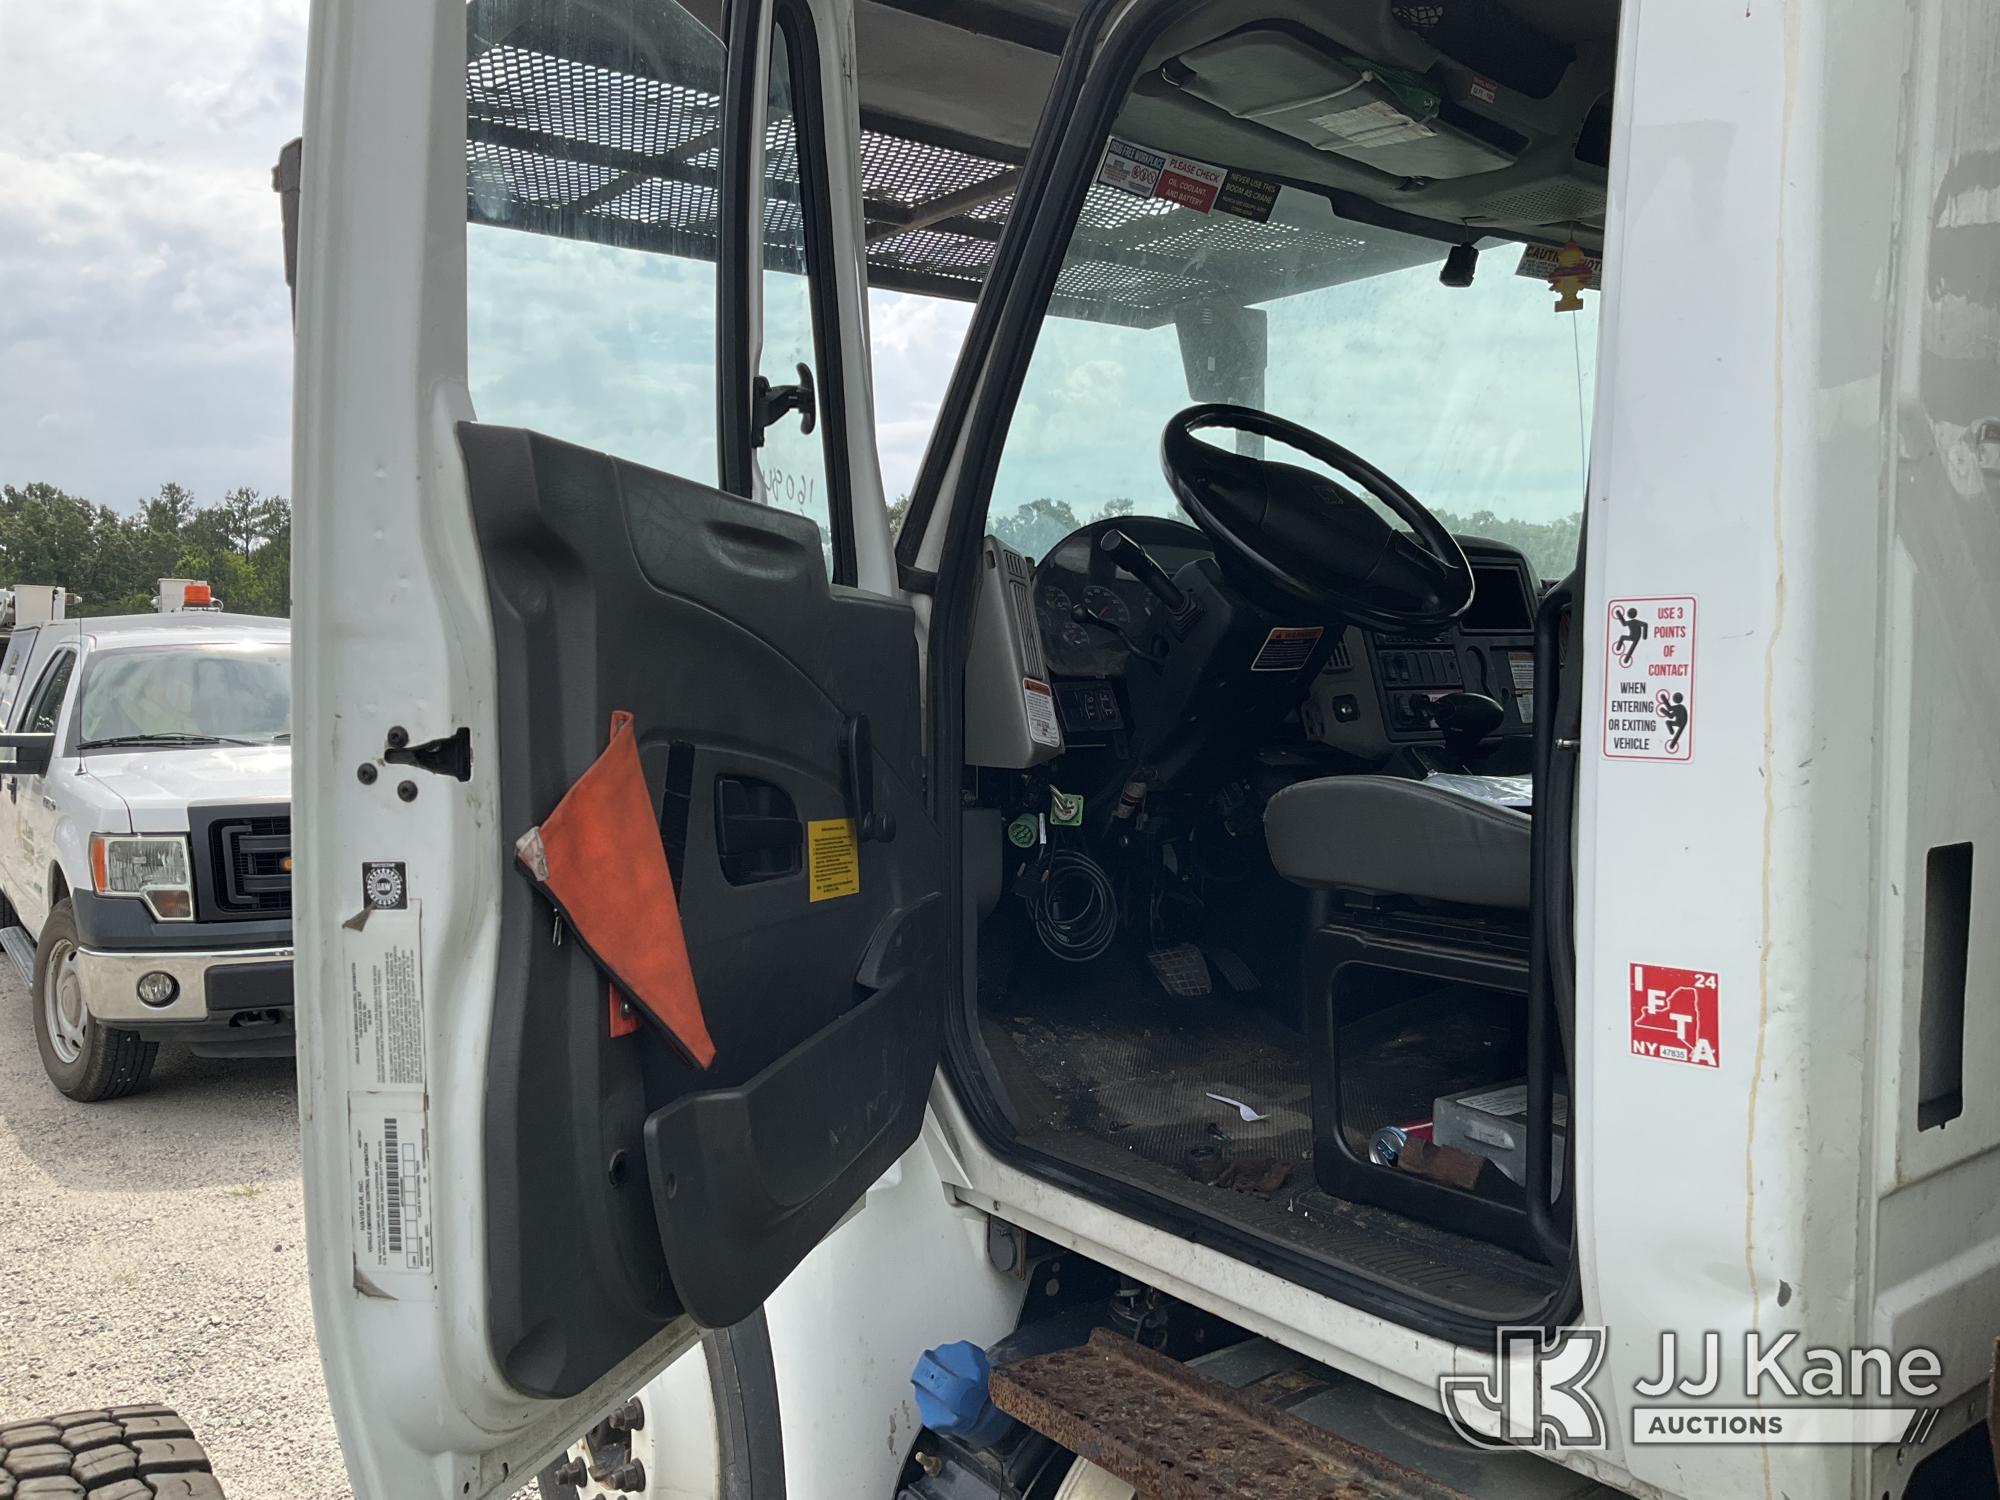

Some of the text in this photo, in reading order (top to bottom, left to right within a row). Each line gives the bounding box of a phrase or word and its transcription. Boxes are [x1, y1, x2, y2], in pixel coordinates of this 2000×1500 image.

[1169, 158, 1220, 184] PLEASE CHECK
[1231, 173, 1276, 193] NEVER USE THIS
[1166, 189, 1203, 206] AND BATTERY
[1657, 607, 1684, 620] USE 3
[1654, 626, 1686, 638] POINTS
[1663, 645, 1675, 657] OF
[1648, 664, 1689, 676] CONTACT
[1620, 682, 1646, 694] WHEN
[1611, 701, 1654, 713] ENTERING
[1608, 718, 1656, 732] OR EXITING
[1613, 737, 1650, 750] VEHICLE
[376, 882, 392, 891] UAW
[1694, 973, 1716, 989] 24
[1633, 1040, 1658, 1056] NY
